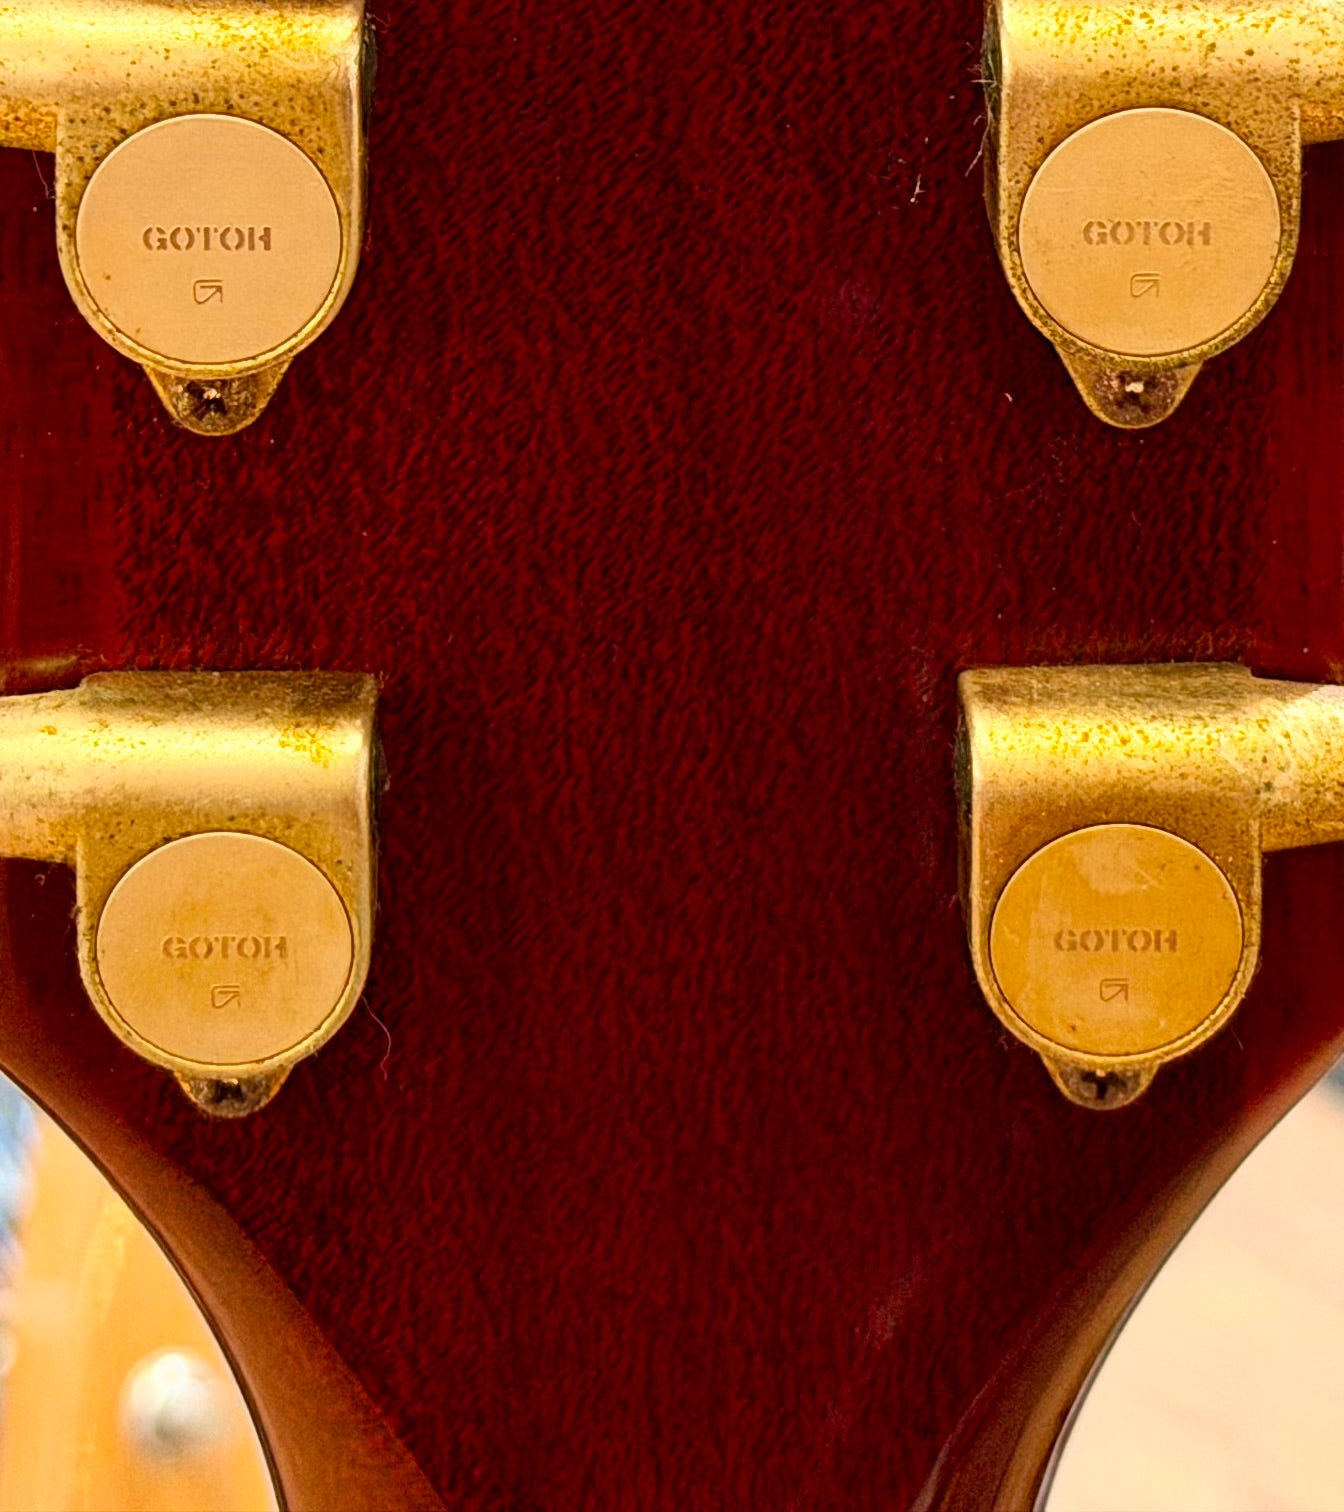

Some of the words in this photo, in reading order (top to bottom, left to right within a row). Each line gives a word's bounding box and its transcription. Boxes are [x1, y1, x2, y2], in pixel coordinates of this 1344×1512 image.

[143, 226, 272, 251] GOTOH
[1082, 221, 1211, 245] GOTOH
[162, 936, 288, 959] GOTOH
[1055, 929, 1178, 953] GOTOH
